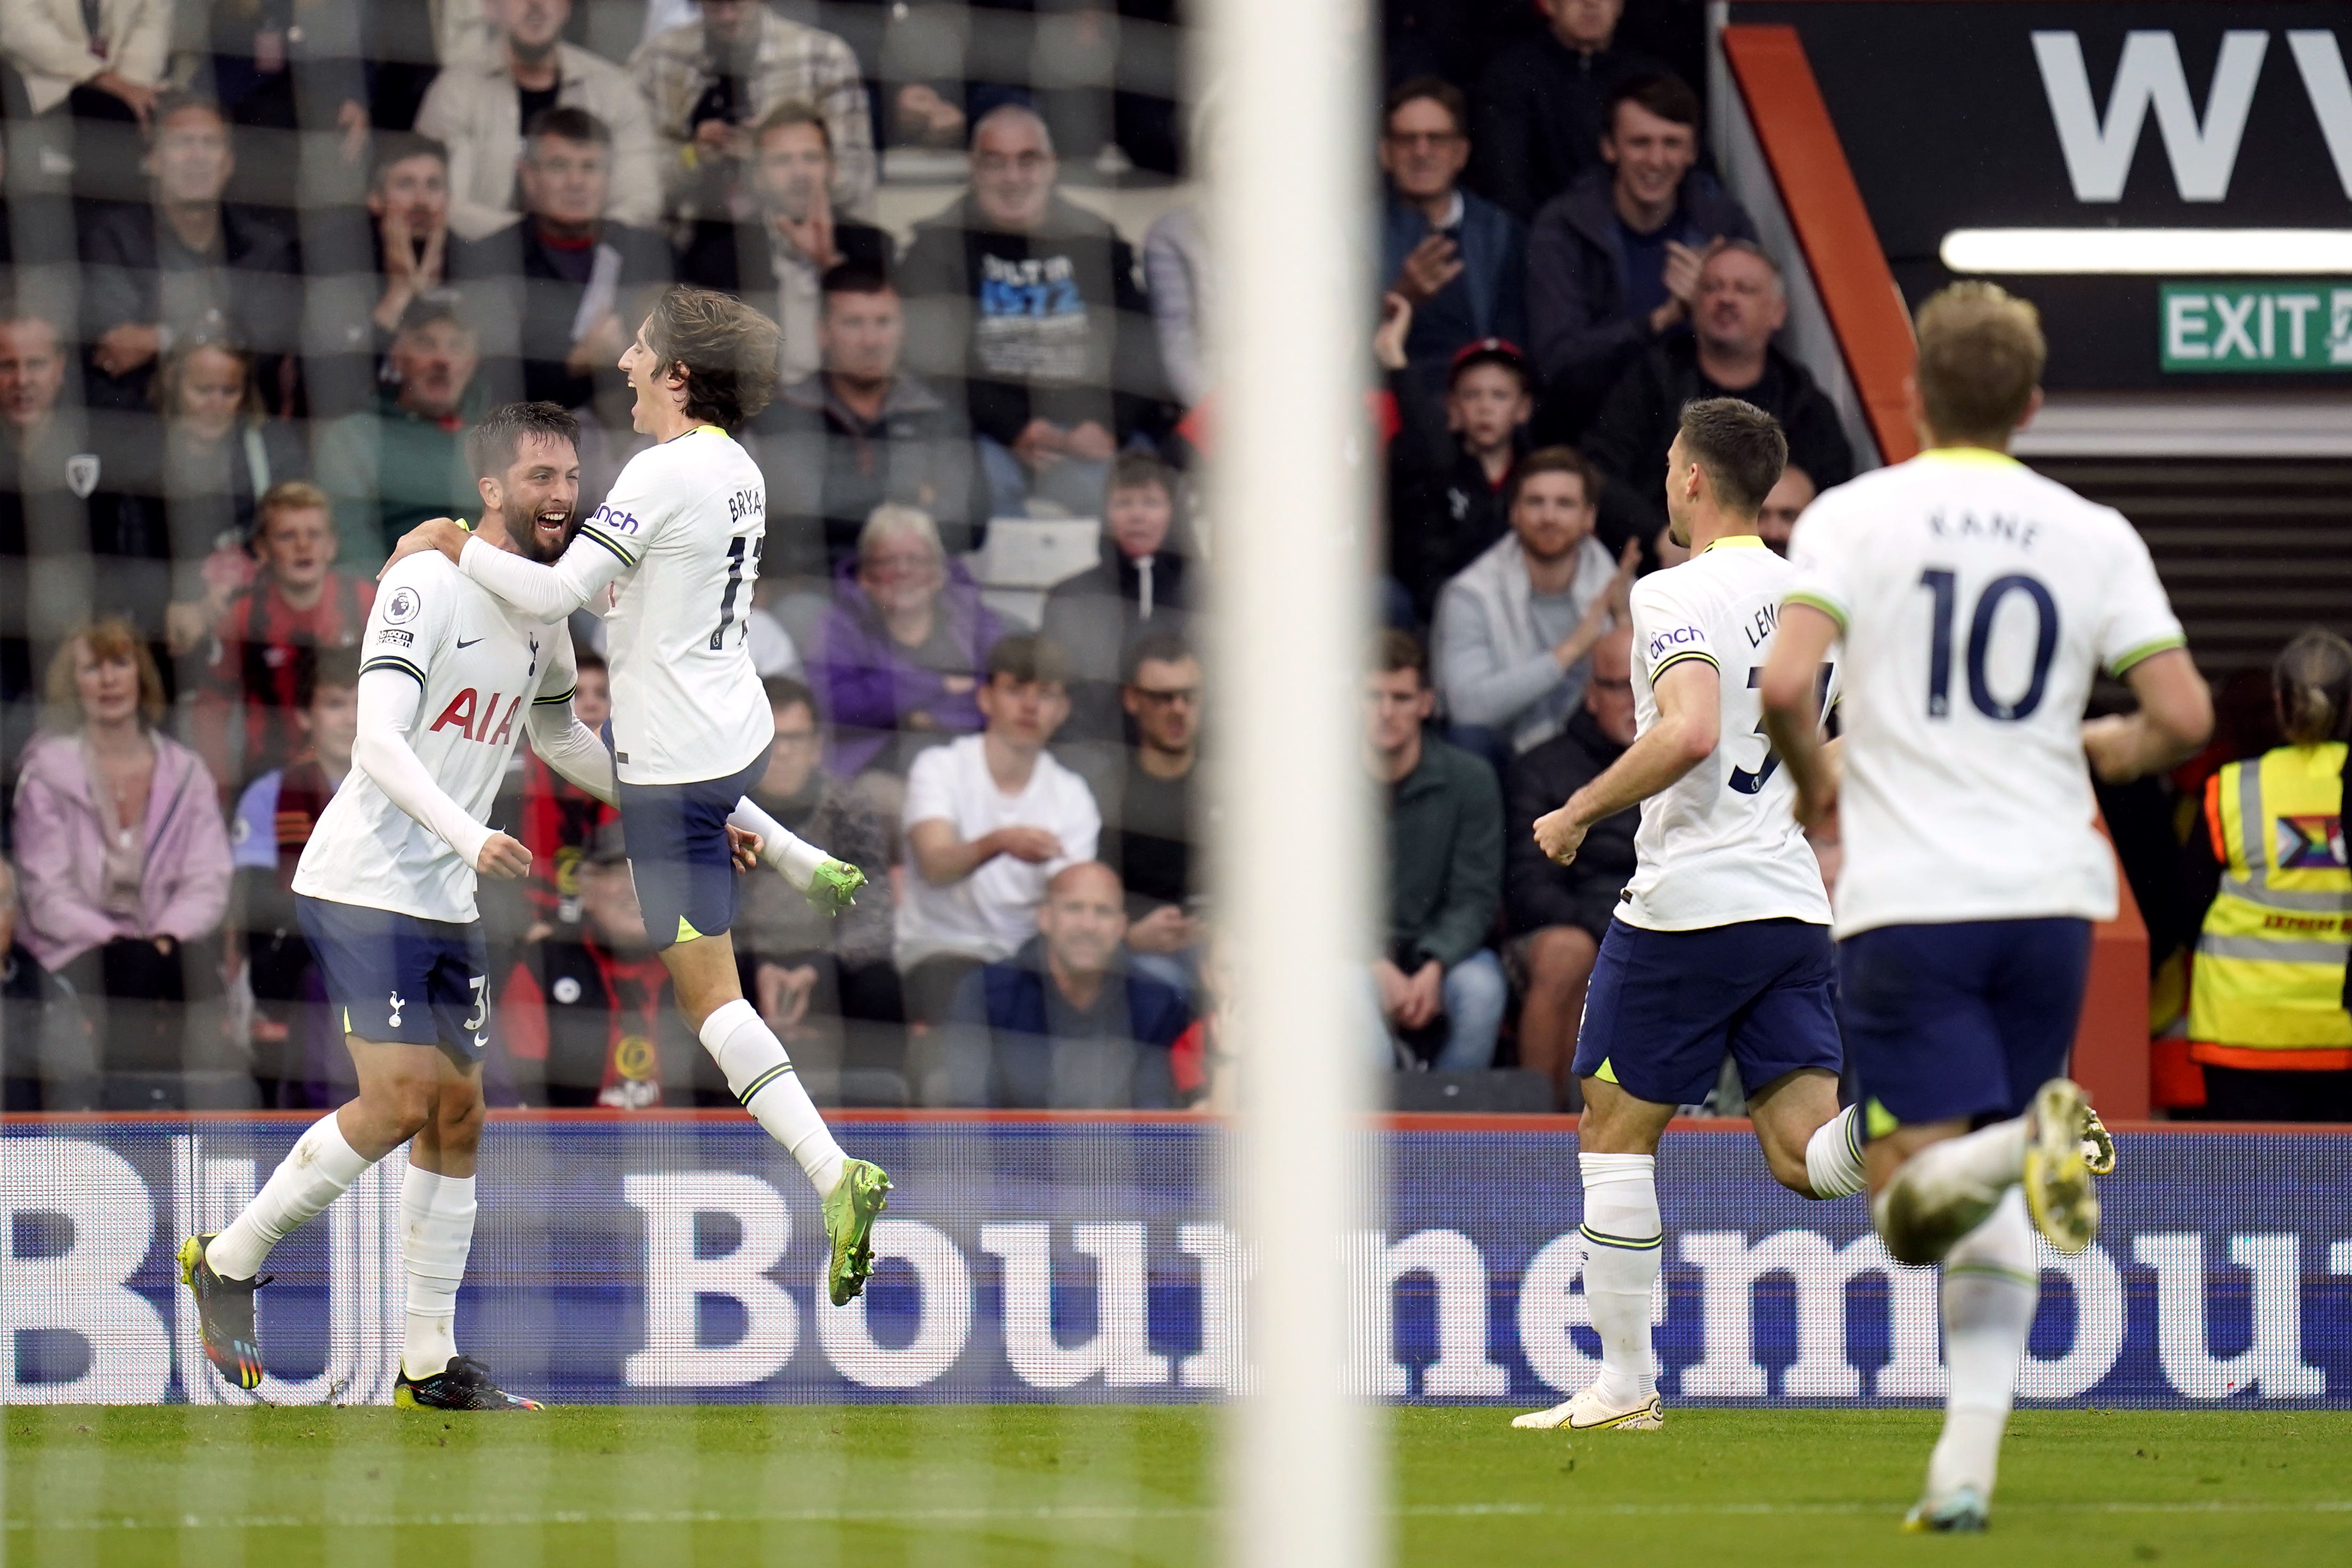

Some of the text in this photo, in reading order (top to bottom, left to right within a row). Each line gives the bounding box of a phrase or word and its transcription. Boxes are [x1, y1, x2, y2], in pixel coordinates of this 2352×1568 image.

[2168, 294, 2321, 360] EXIT
[728, 489, 763, 523] BRYA
[1927, 510, 2042, 550] KANE
[387, 630, 410, 641] room
[1651, 626, 1705, 659] cinch
[1745, 603, 1777, 649] LEN
[1921, 570, 2059, 720] 10
[429, 688, 521, 745] AIA
[1728, 662, 1834, 794] 3
[463, 974, 491, 1030] 3
[623, 1170, 2352, 1399] Bournemou
